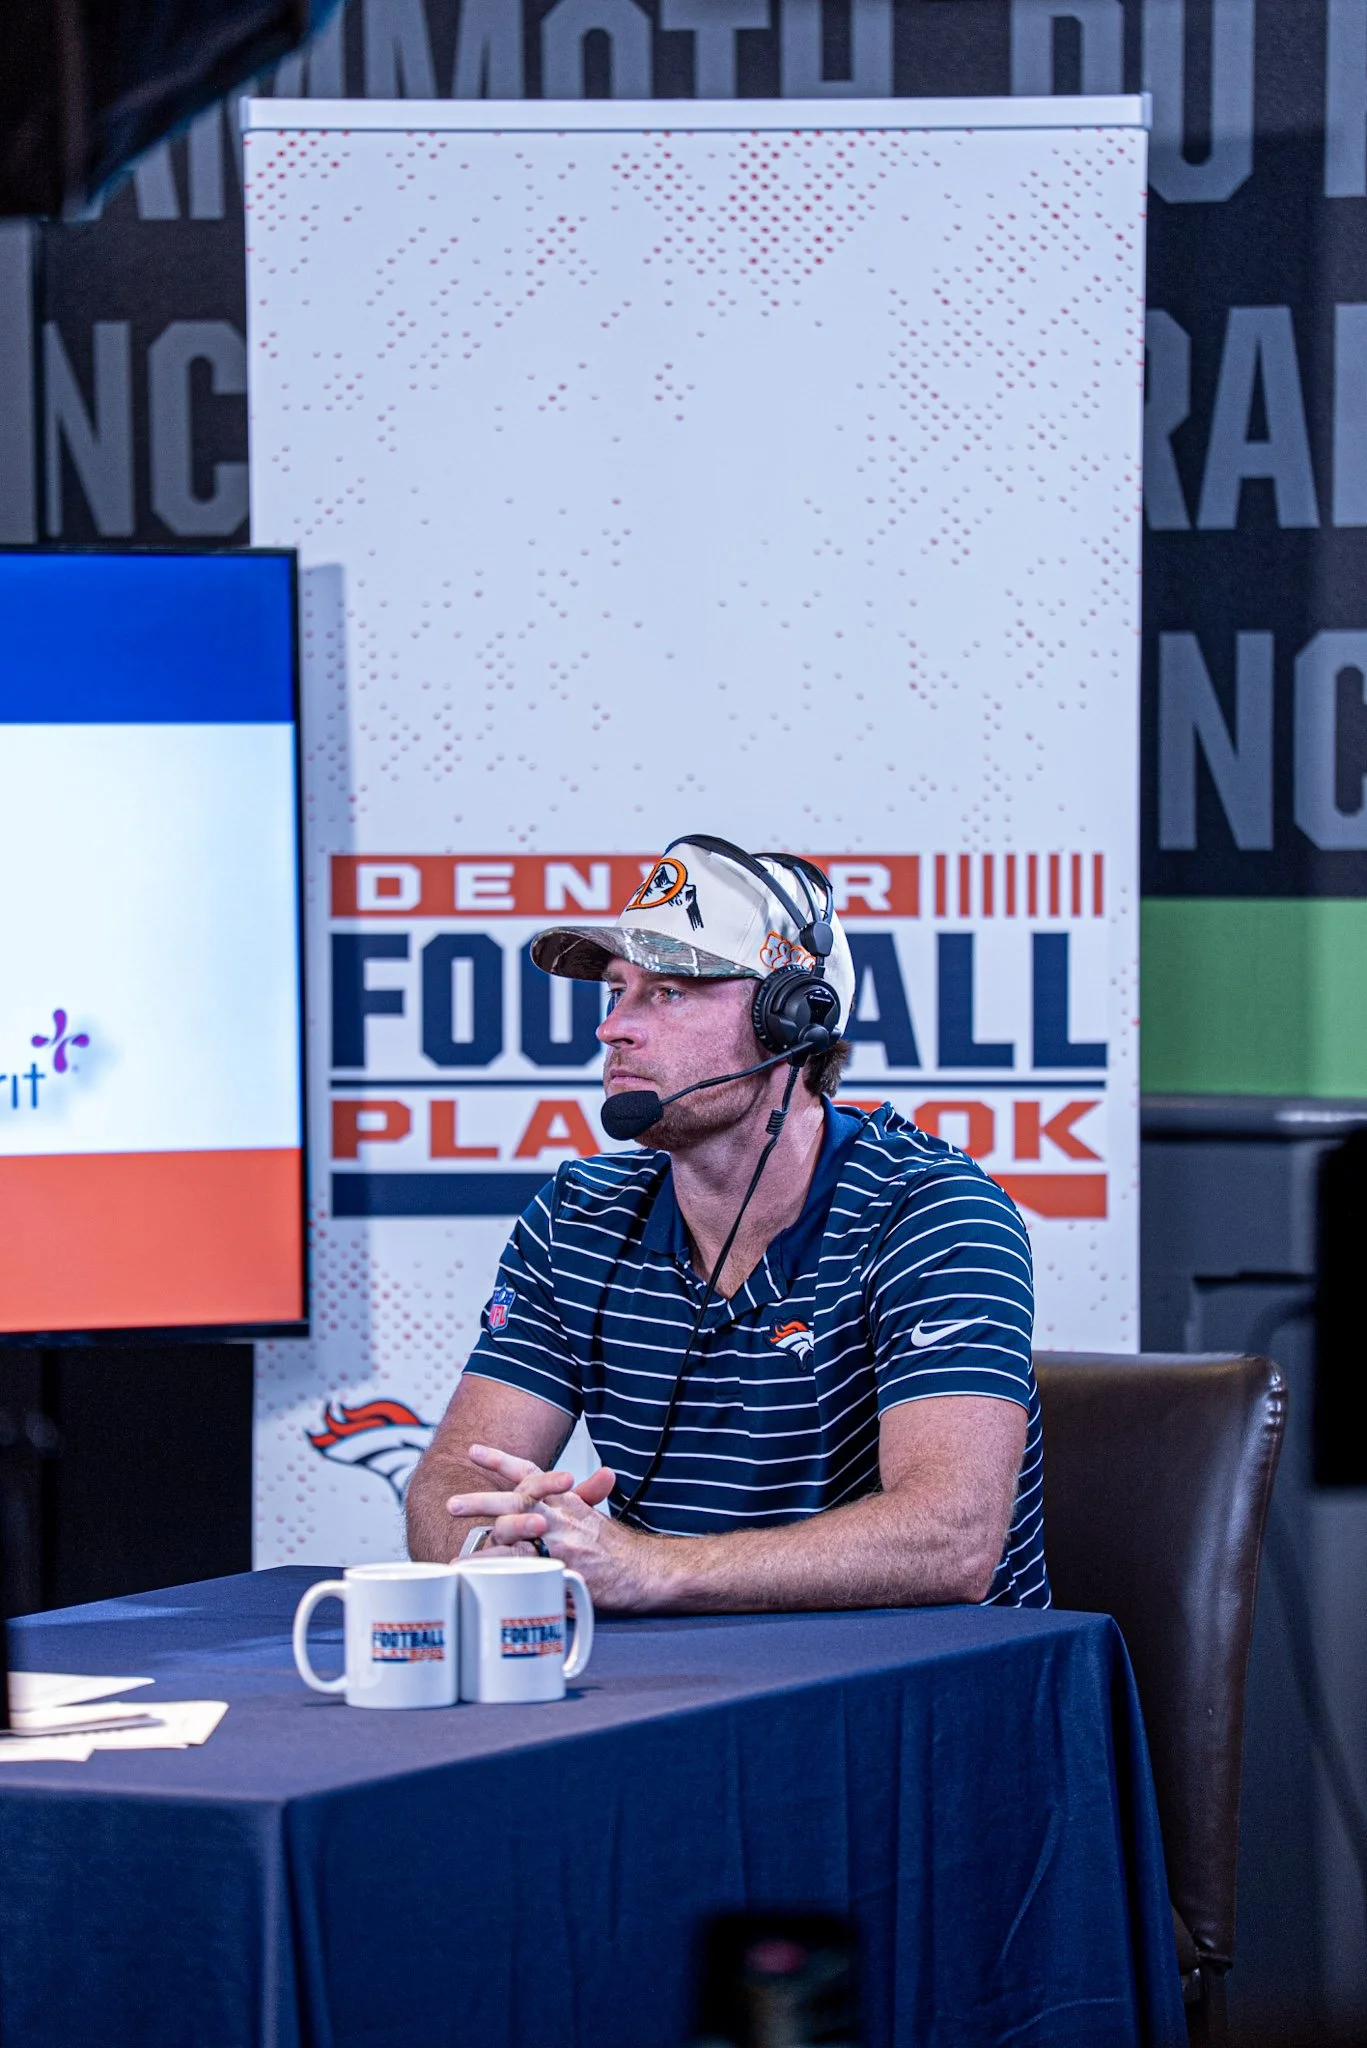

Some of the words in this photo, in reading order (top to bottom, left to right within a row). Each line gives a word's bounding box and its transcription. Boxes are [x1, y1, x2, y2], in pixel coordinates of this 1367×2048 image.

[356, 863, 892, 911] DENR
[331, 932, 1108, 1069] FOOALL
[0, 1062, 46, 1109] it
[331, 1100, 1104, 1161] PLAOK
[371, 1631, 445, 1647] FOOTBALL
